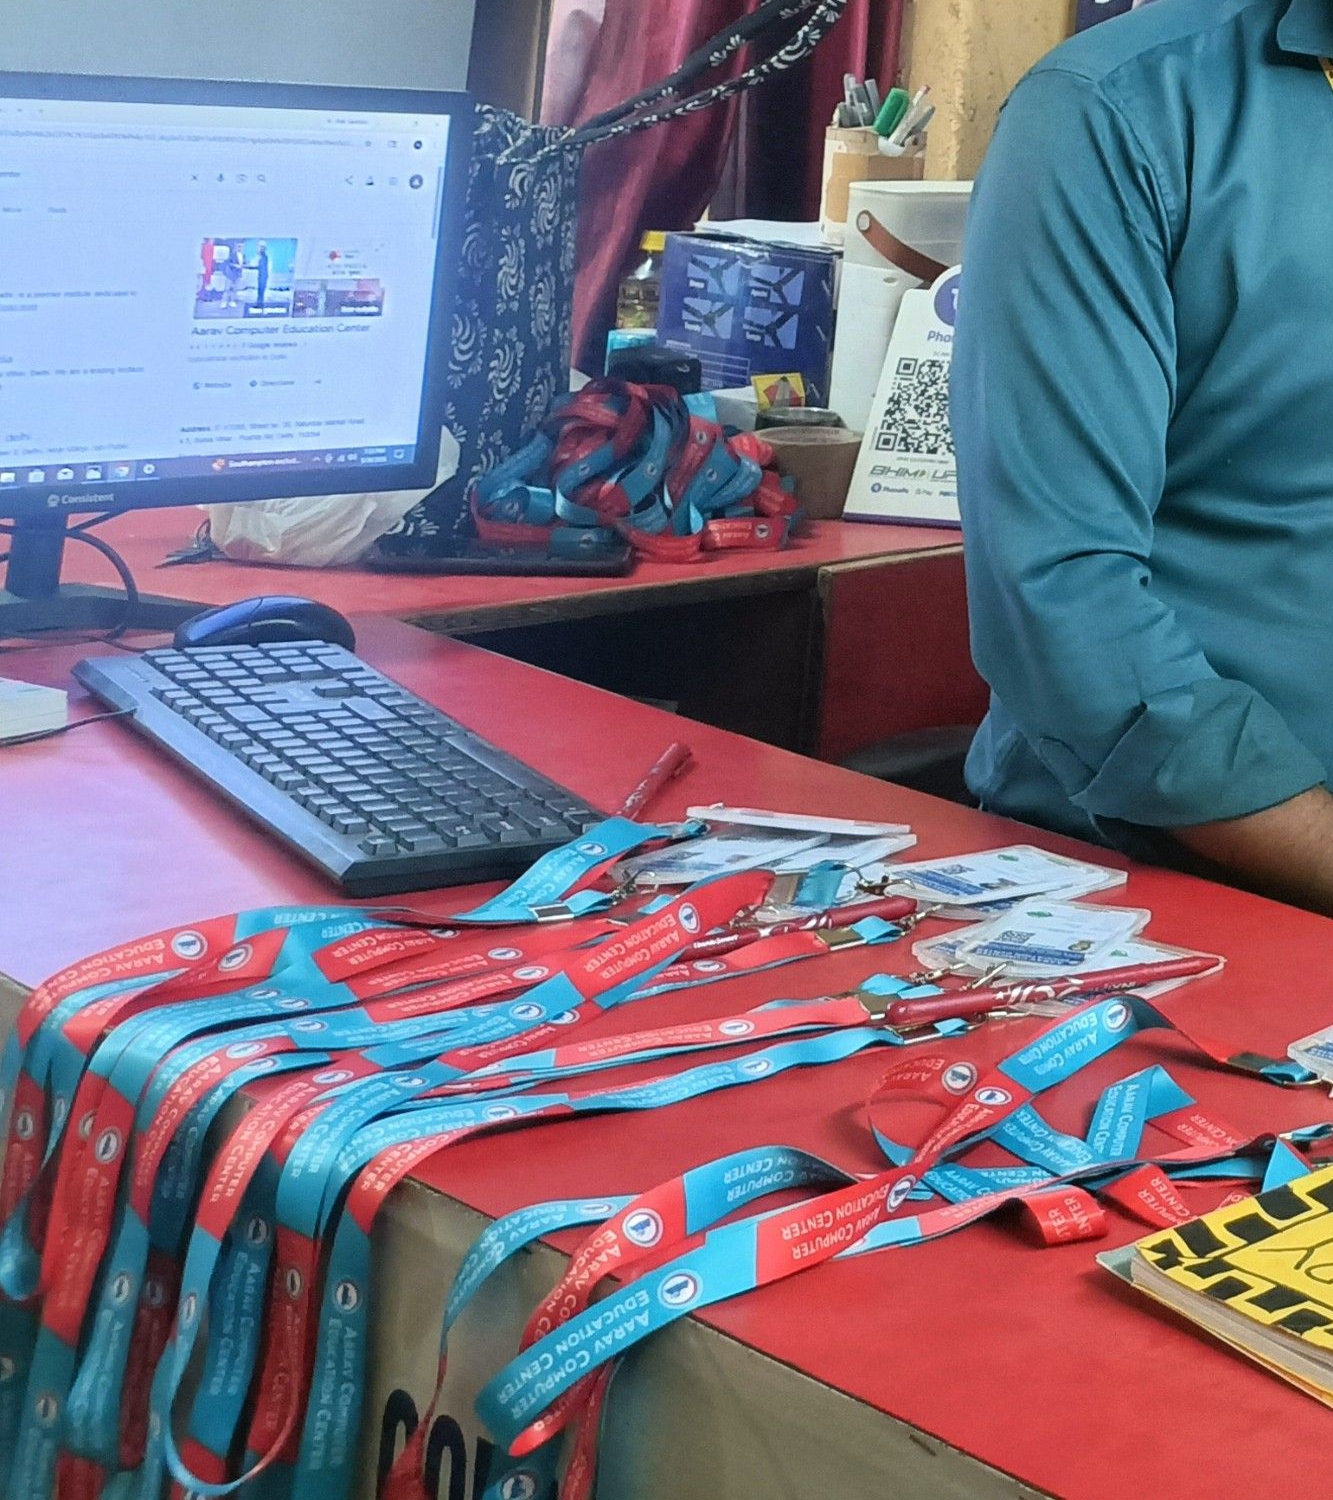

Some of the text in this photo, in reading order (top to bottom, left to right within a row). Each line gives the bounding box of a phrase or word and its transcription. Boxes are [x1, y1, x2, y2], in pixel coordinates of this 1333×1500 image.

[225, 325, 280, 337] Computer
[282, 324, 334, 334] Education
[336, 323, 371, 333] Center
[82, 938, 165, 969] EDUCATION
[115, 952, 165, 972] AARAV
[583, 913, 676, 972] EDUCATION CENTER
[600, 930, 680, 979] AARAV COMPUTER
[210, 1144, 241, 1202] CENTER
[225, 1120, 275, 1197] COMPUTER
[724, 1156, 773, 1183] CENTER
[781, 1183, 889, 1241] EDUCATION CENTER
[792, 1223, 853, 1260] COMPUTER
[574, 1245, 621, 1290] AARAV
[496, 1290, 650, 1404] EDUCATION CENTER
[510, 1310, 650, 1419] AARAV COMPUTER
